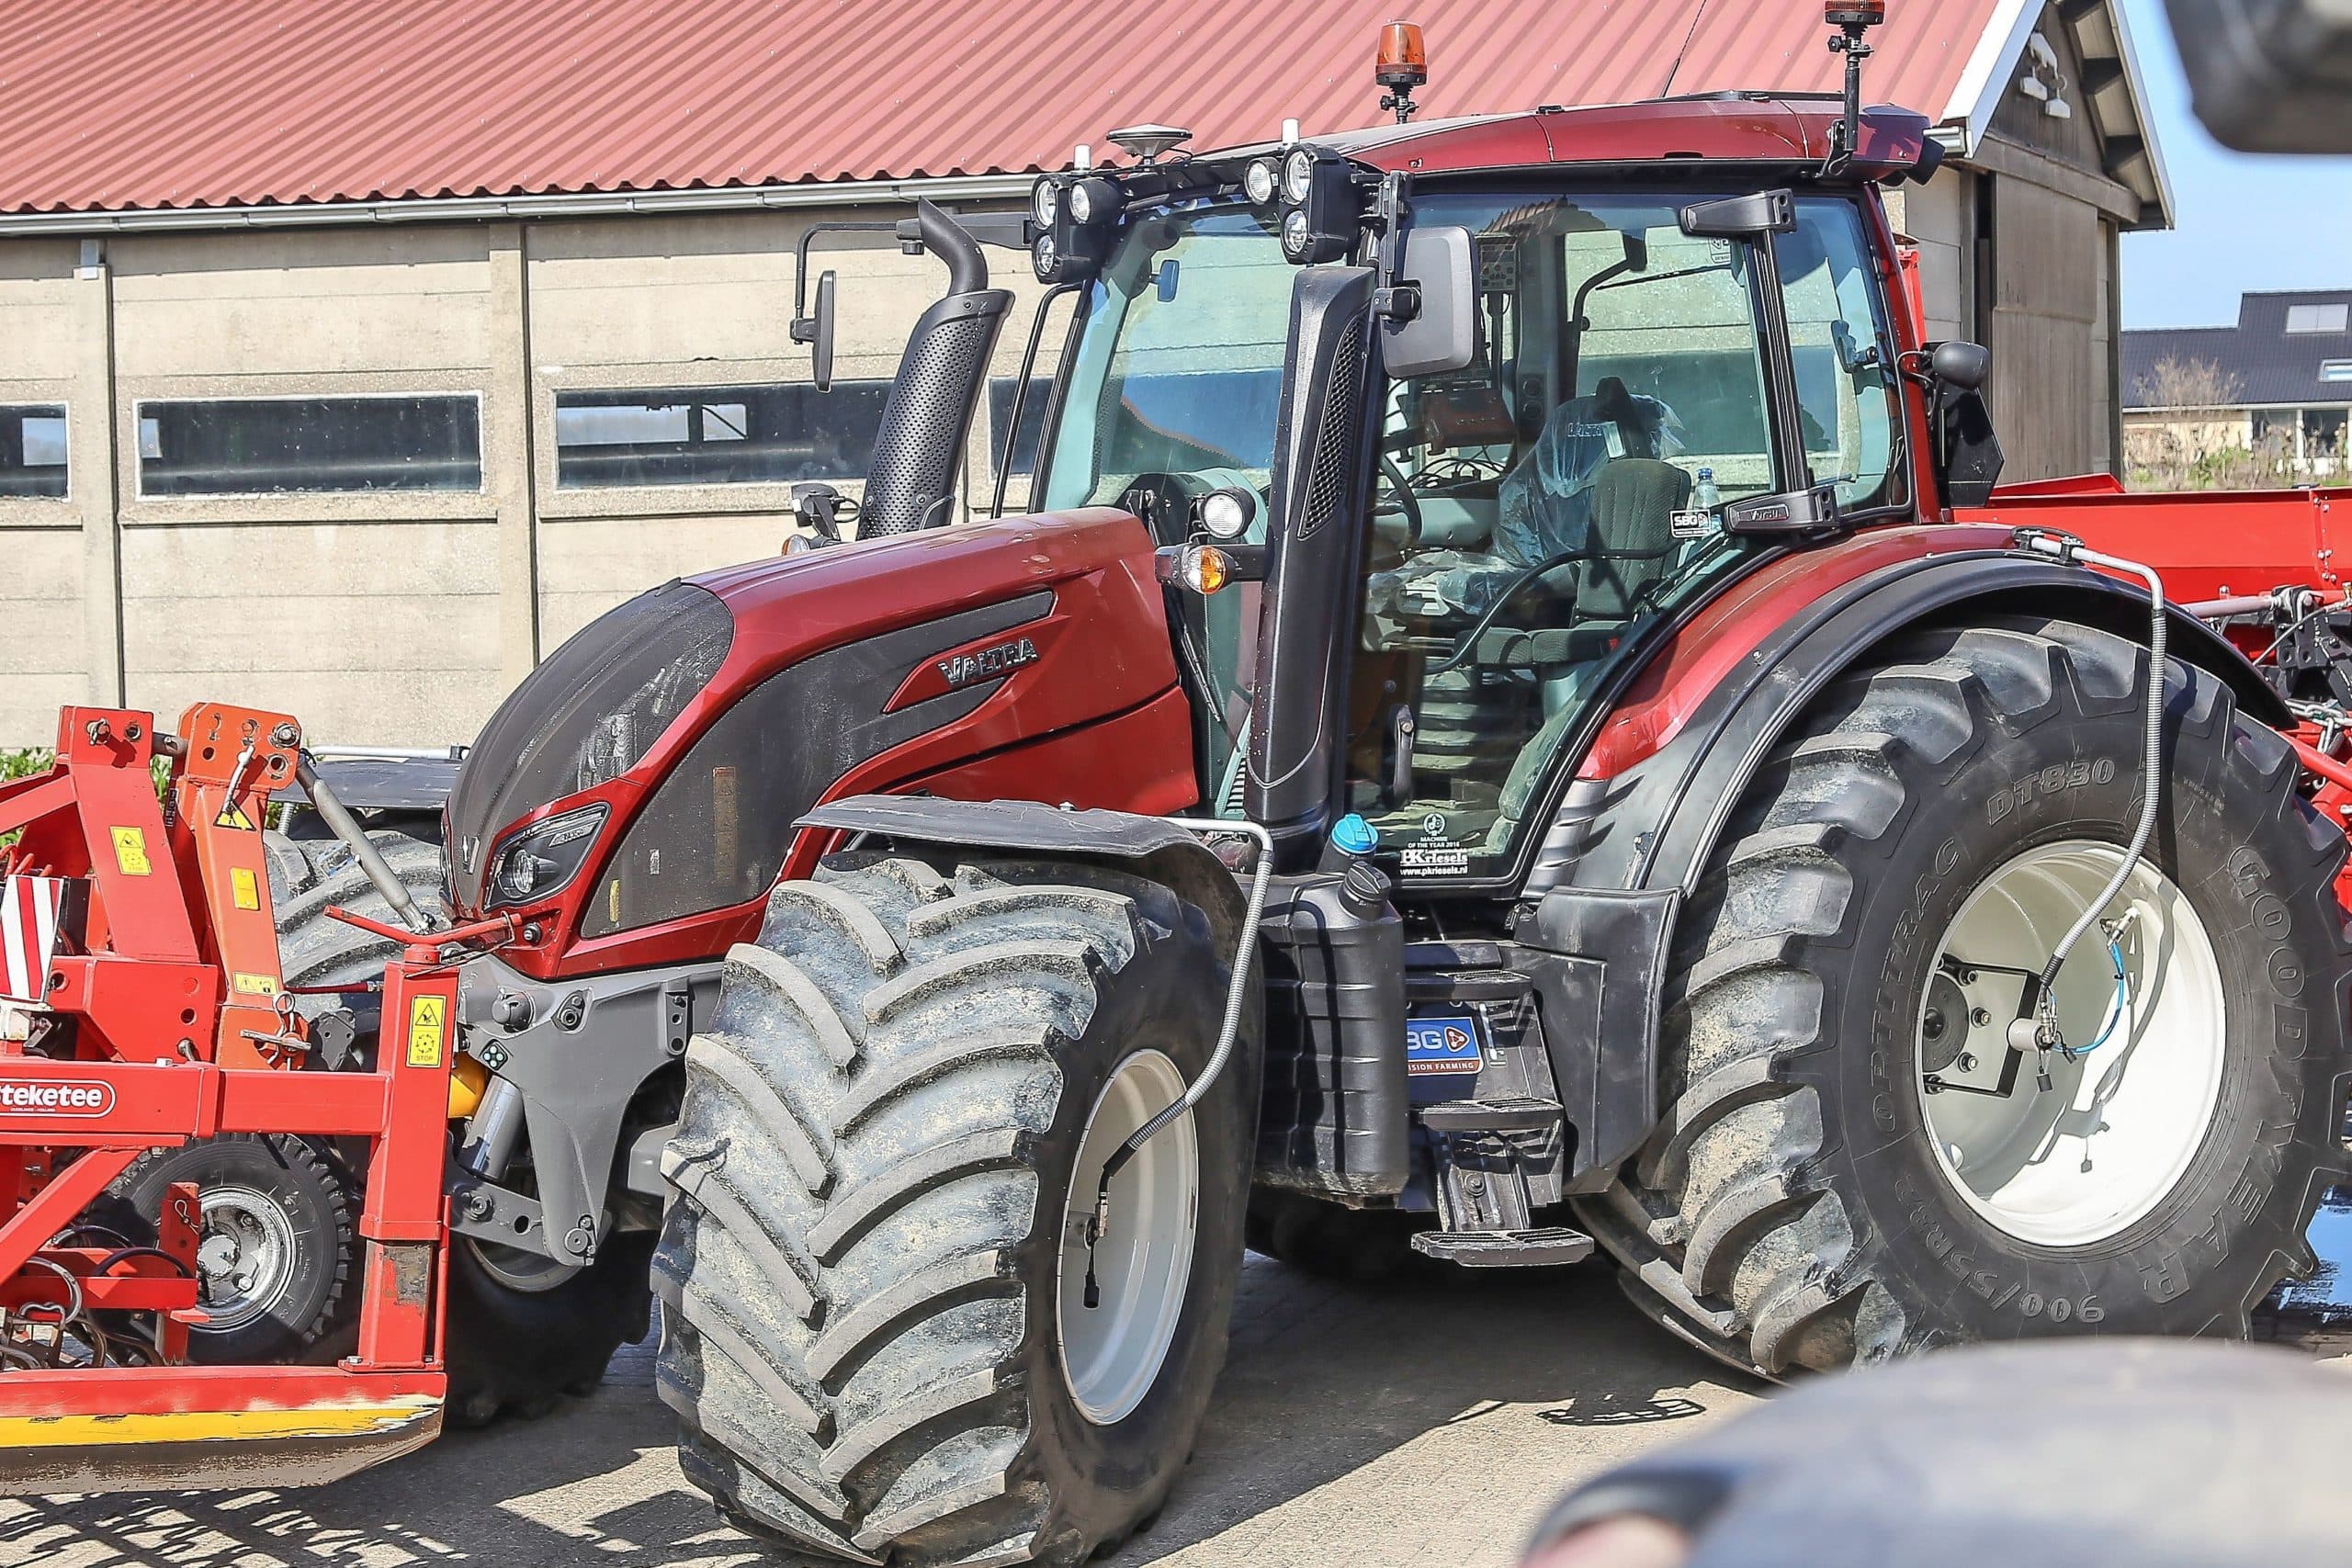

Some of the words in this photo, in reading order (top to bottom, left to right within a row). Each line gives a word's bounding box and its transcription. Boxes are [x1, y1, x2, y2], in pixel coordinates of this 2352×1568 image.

[1674, 513, 1698, 527] SBG
[937, 638, 1038, 682] VALTRA
[1987, 756, 2117, 827] DT830
[1399, 866, 1468, 877] www.pkriesels.nl
[1871, 836, 1960, 1132] OPTITRAC
[1408, 1031, 1442, 1051] BG
[1434, 1062, 1474, 1070] FARMING
[2143, 844, 2306, 1304] GOODYEAR
[0, 1084, 103, 1108] teketee
